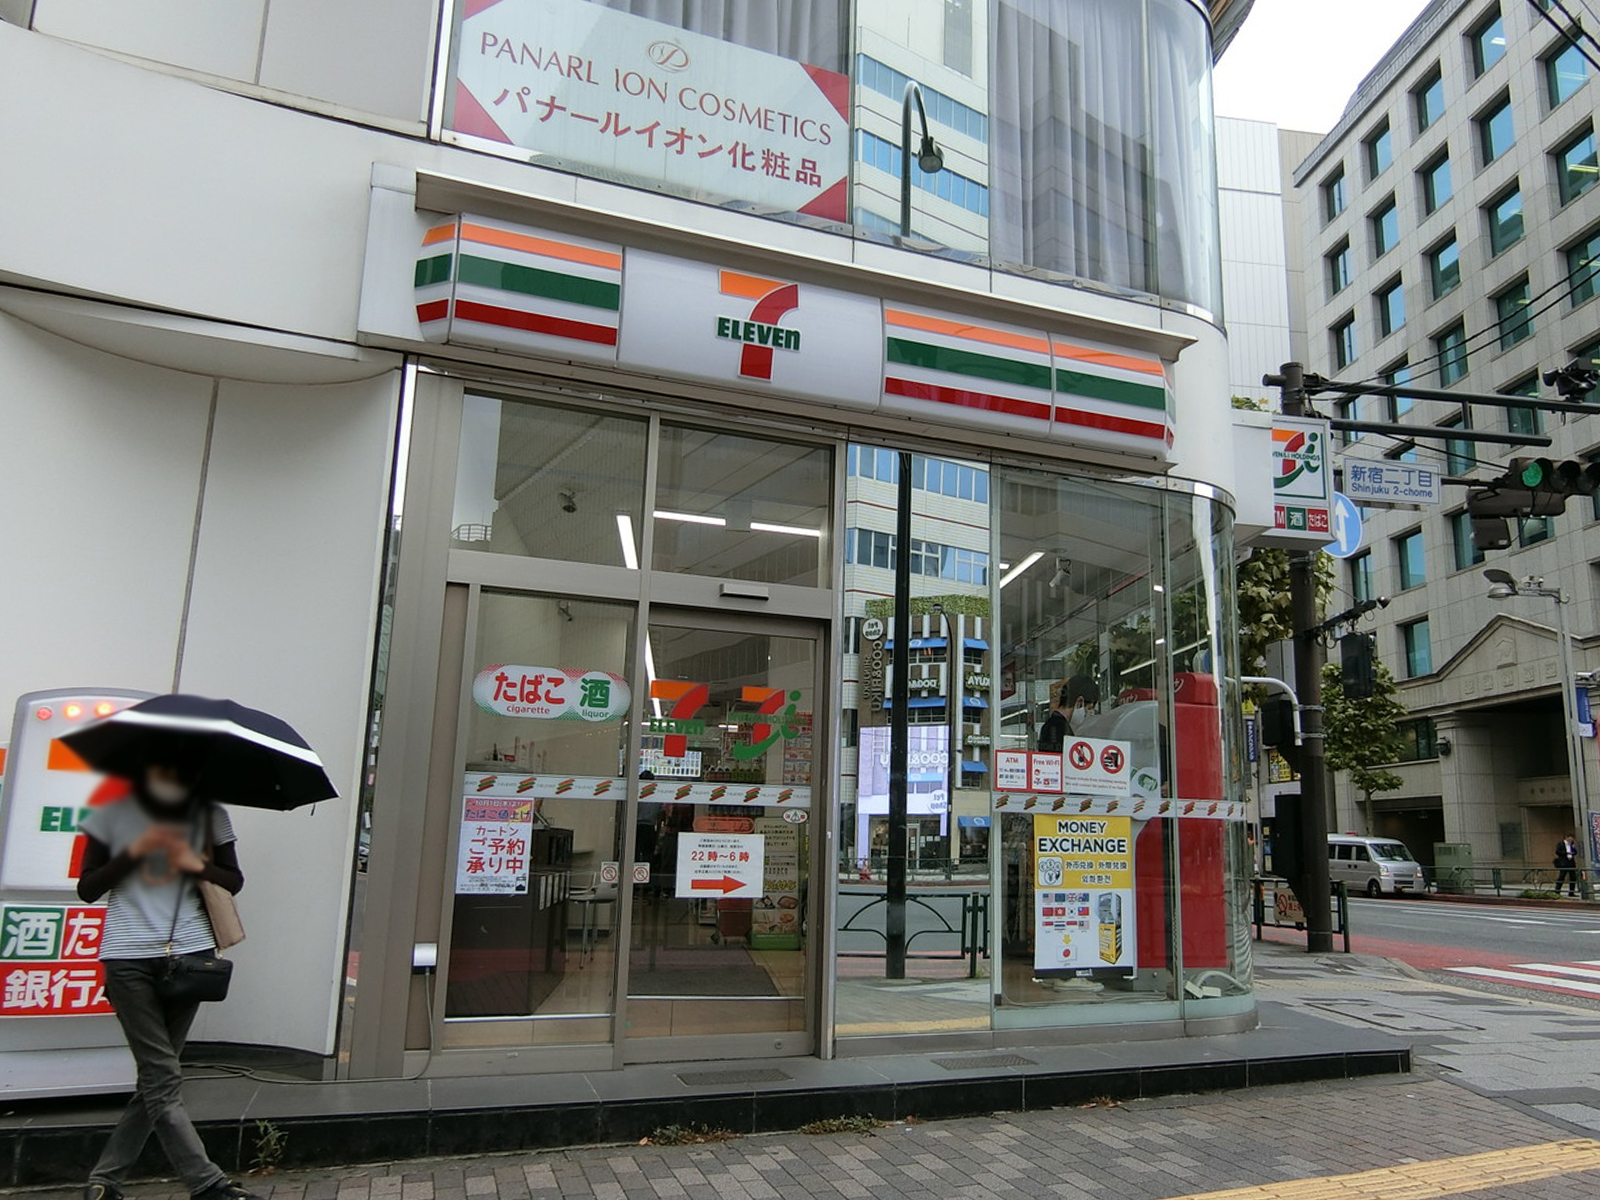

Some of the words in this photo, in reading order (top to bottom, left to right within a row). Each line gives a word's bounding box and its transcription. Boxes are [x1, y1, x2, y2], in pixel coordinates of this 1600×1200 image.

[480, 31, 599, 86] PANARL
[614, 67, 669, 104] ION
[678, 86, 832, 146] COSMETICS
[493, 84, 823, 188] パナールイオン化粧品
[1350, 465, 1432, 488] 新宿二丁目
[1351, 483, 1390, 496] Shinjuku
[1393, 486, 1433, 498] 2-chome
[1289, 511, 1303, 526] 酒
[1308, 513, 1328, 528] たばこ
[493, 672, 566, 705] たばこ
[579, 678, 611, 709] 酒
[506, 705, 551, 715] cigarette
[581, 709, 611, 719] liquor
[476, 826, 519, 836] カートン
[1058, 821, 1107, 833] MONEY
[469, 838, 525, 856] ご予約
[1038, 838, 1127, 853] EXCHANGE
[466, 857, 523, 874] 承り中
[2, 911, 61, 958] 酒
